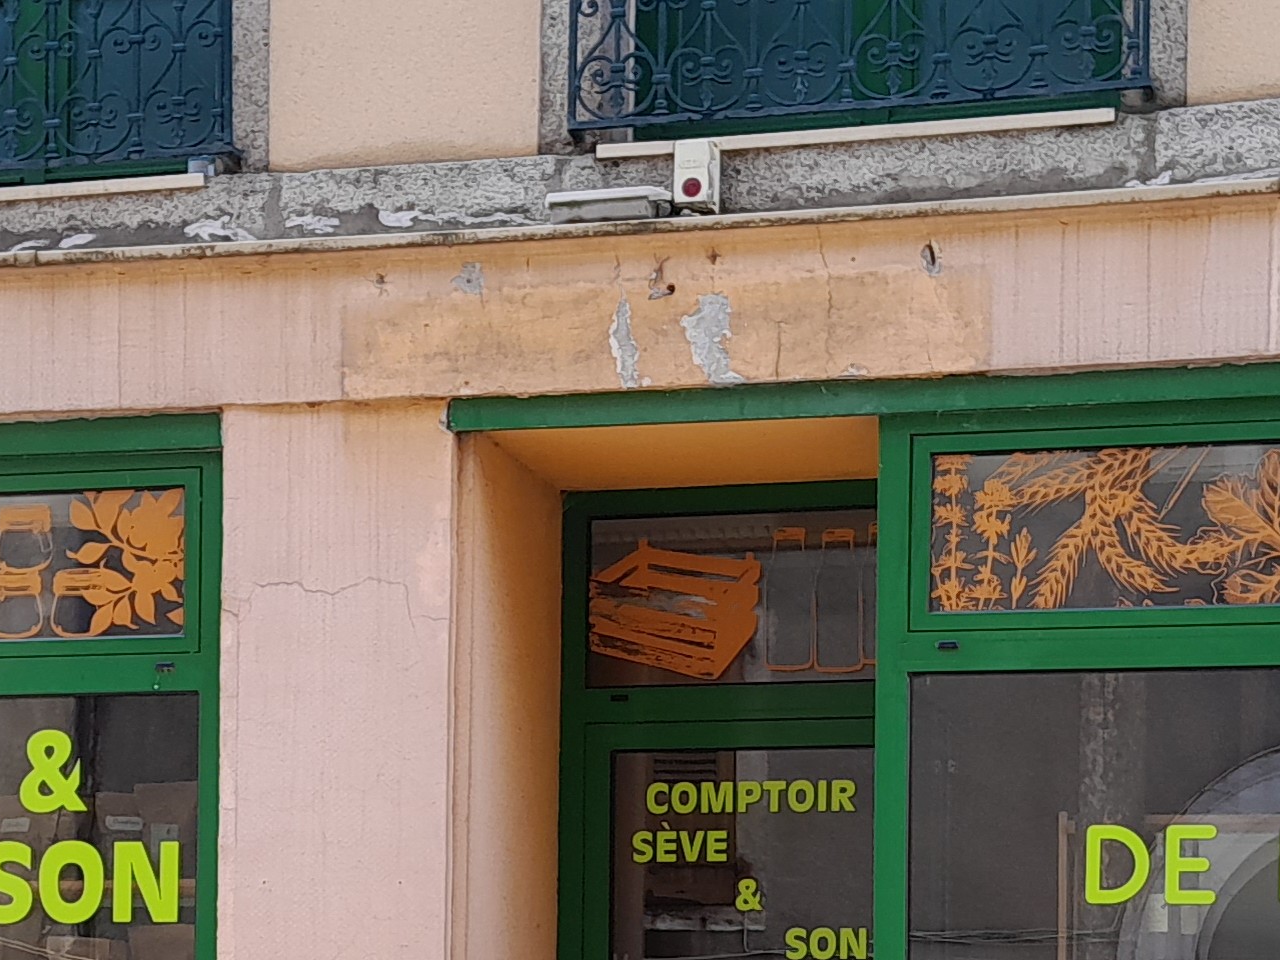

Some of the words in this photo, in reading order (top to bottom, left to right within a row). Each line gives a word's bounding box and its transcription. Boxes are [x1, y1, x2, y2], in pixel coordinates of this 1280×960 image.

[19, 729, 88, 813] &
[646, 779, 856, 814] COMPTOIR
[632, 823, 727, 863] SÈVE
[1084, 823, 1218, 907] DE
[735, 879, 763, 911] &
[785, 927, 868, 960] SON
